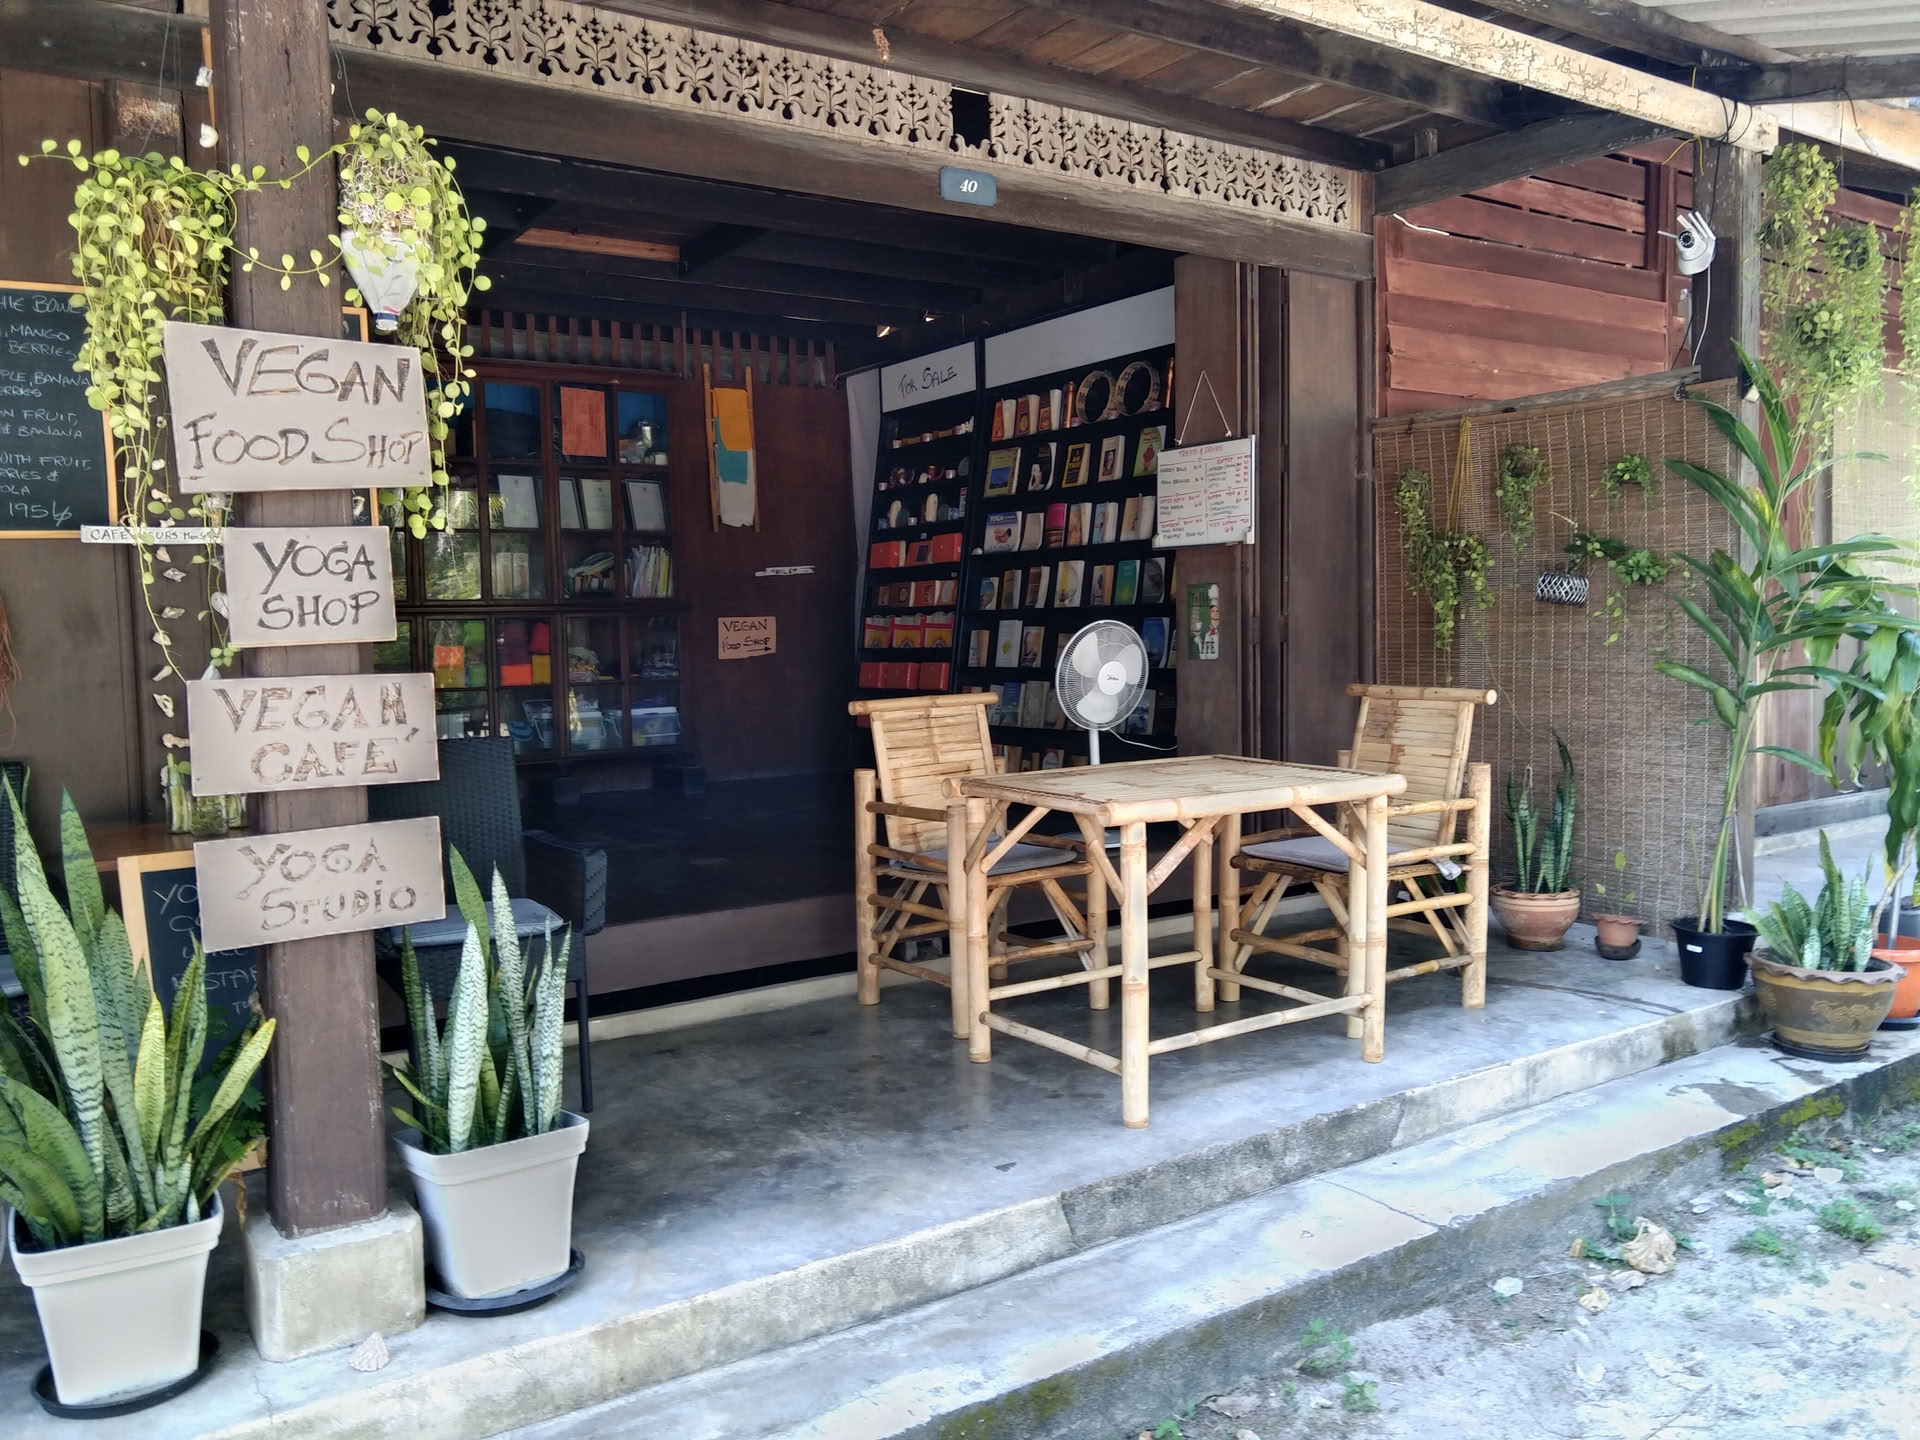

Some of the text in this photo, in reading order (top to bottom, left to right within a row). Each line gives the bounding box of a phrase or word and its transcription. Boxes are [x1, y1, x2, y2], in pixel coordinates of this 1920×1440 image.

[960, 179, 978, 193] 40
[8, 340, 77, 361] BERRIES
[200, 337, 411, 406] VEGAN
[922, 367, 957, 389] SALE
[18, 425, 82, 439] BANANA
[183, 411, 425, 470] FOOD SHOP
[252, 538, 377, 595] YOGA
[257, 590, 380, 630] SHOP
[722, 619, 767, 632] VEGAN
[213, 682, 408, 733] VEGAN
[235, 838, 388, 900] YOGA
